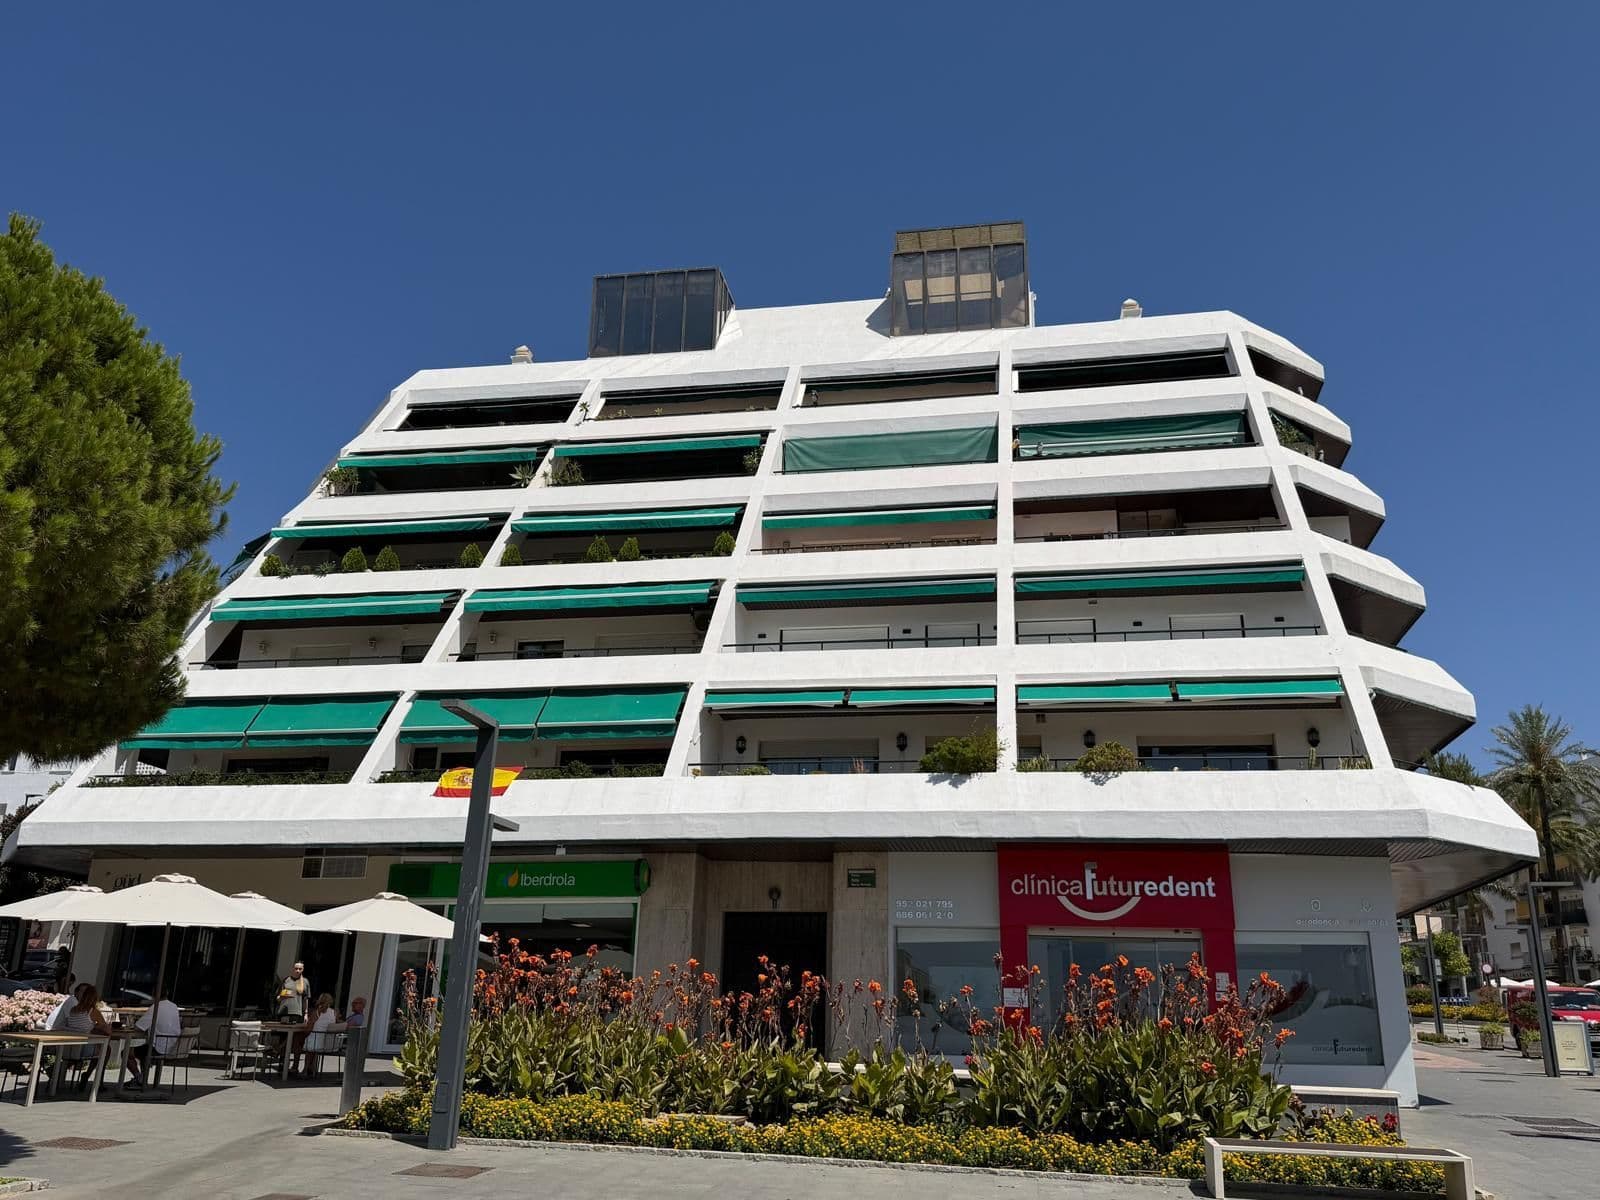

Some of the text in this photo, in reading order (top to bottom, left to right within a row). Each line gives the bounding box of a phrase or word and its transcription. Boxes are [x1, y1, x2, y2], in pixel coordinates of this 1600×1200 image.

[520, 872, 577, 887] Iberdrola
[1010, 873, 1084, 896] clínica
[936, 911, 954, 920] 20
